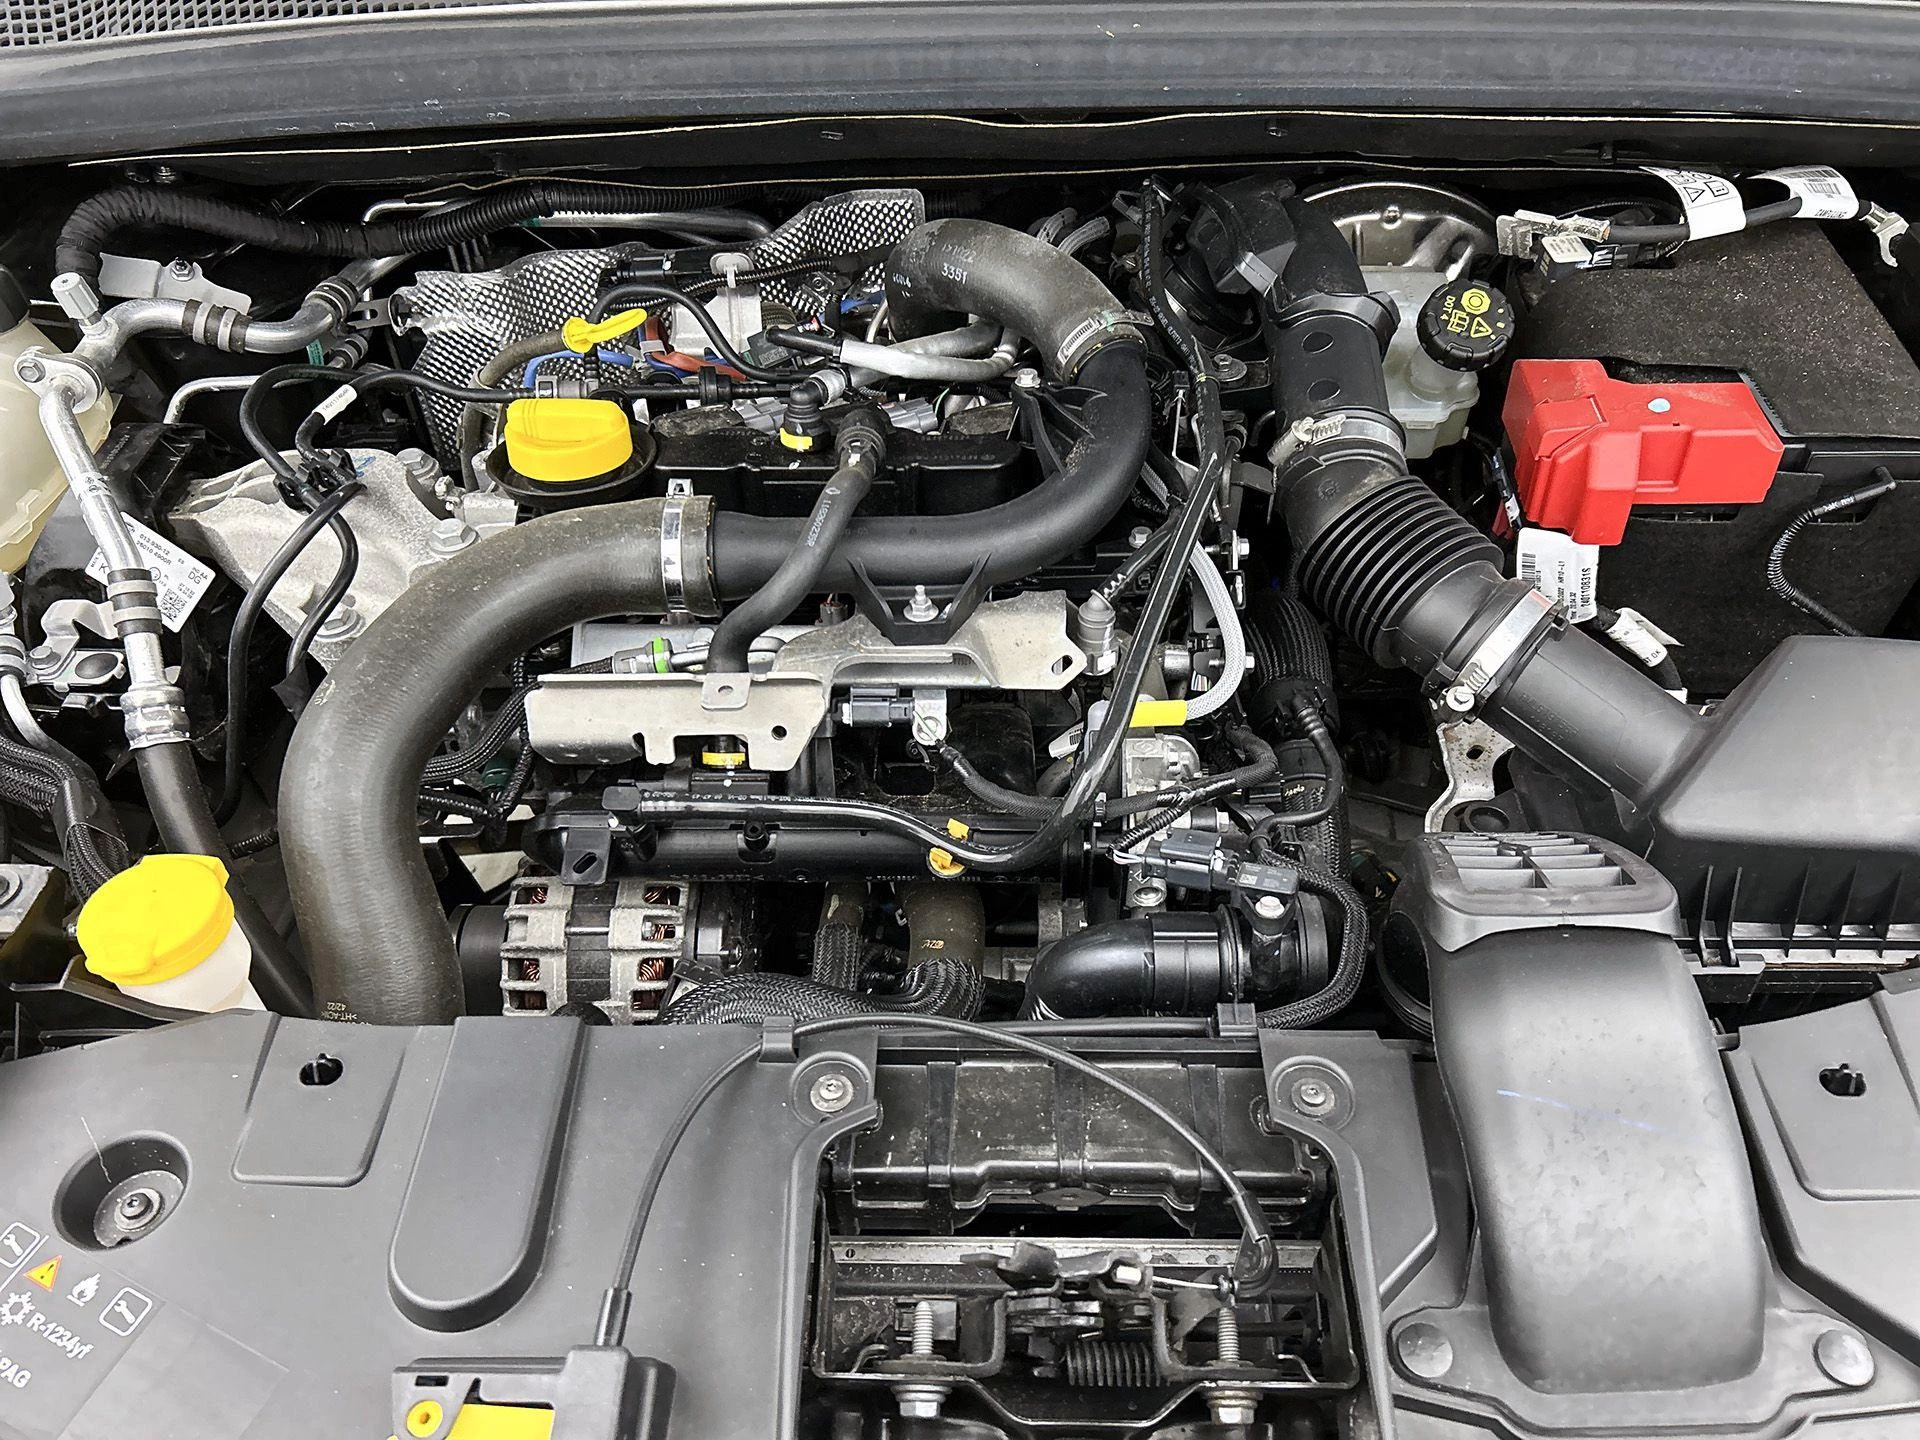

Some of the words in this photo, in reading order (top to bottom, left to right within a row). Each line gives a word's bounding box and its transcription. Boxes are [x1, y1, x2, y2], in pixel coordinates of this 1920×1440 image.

[1443, 295, 1456, 313] DOT
[187, 571, 201, 585] DG
[26, 1312, 95, 1359] R-1234yf
